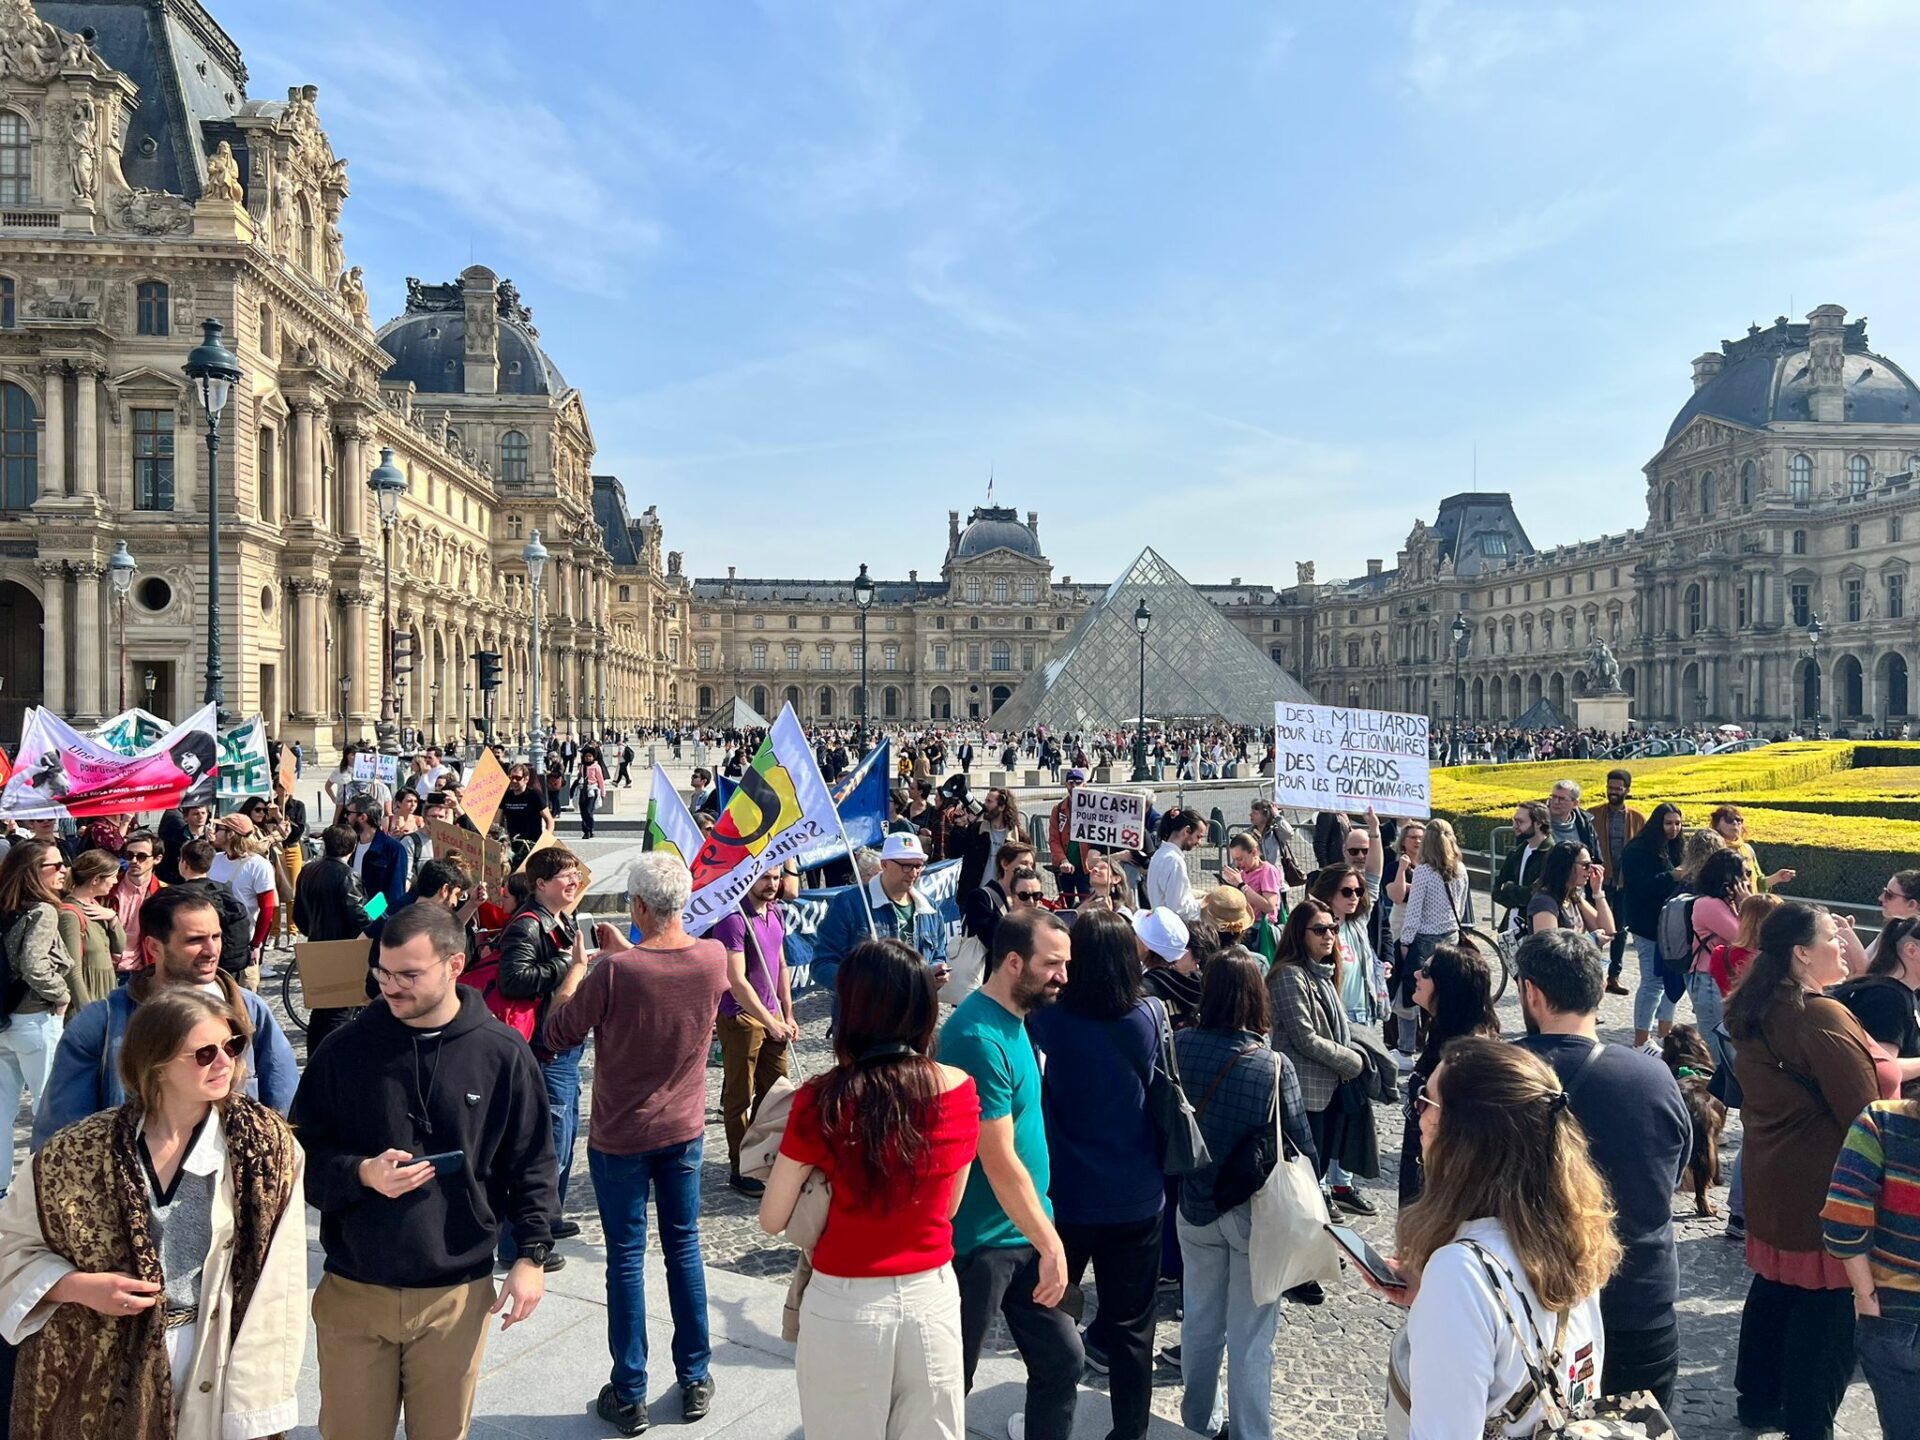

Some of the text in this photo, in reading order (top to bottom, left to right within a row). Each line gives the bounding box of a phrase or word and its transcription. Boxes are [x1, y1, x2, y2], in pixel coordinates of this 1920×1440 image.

[1286, 707, 1314, 723] DES
[1277, 725, 1306, 741] POUR
[1313, 729, 1333, 745] LES
[1285, 752, 1400, 781] DES CAFARDS
[1277, 773, 1306, 790] POUR
[1312, 778, 1329, 792] LES
[1077, 793, 1096, 808] DU
[1076, 811, 1097, 822] POUR
[1099, 814, 1114, 824] DES
[1075, 823, 1140, 848] AESH 93
